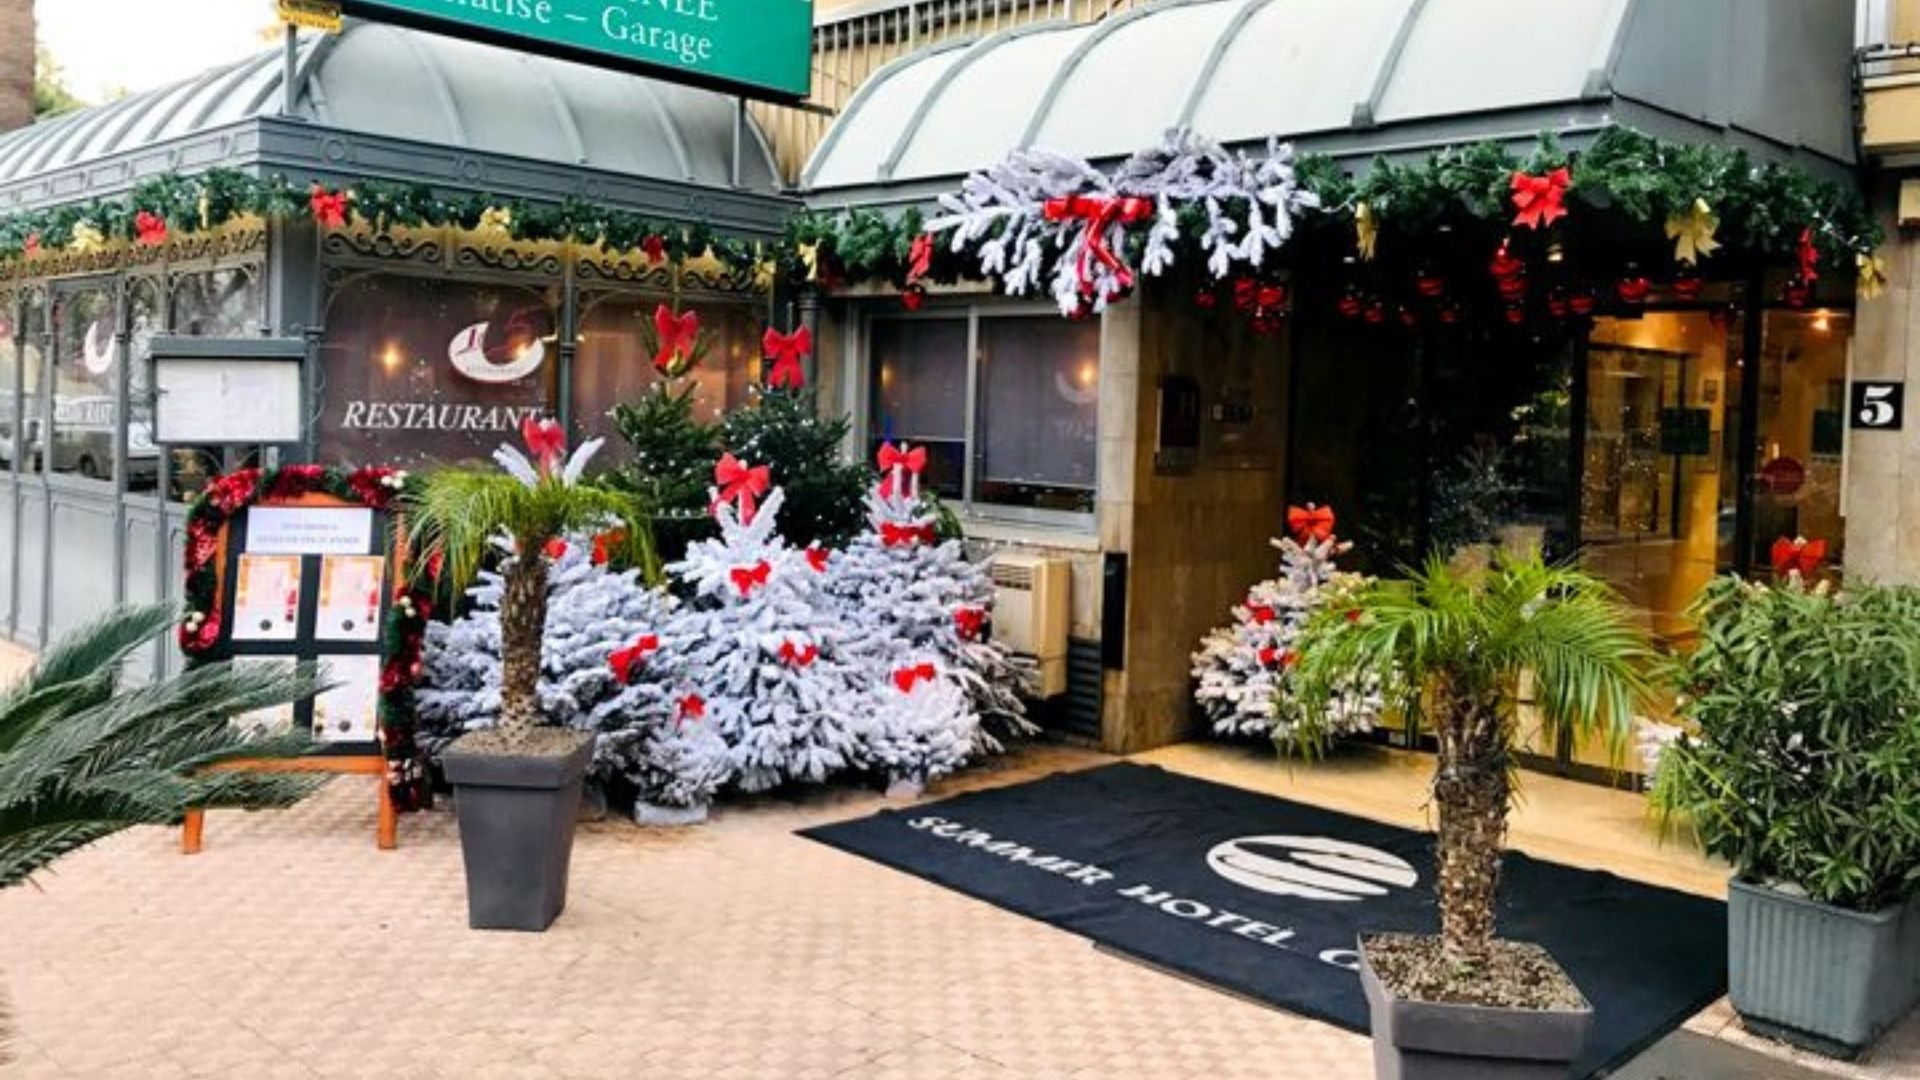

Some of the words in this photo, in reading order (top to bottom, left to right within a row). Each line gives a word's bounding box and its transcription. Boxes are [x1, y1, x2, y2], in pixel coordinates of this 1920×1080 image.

[602, 6, 711, 63] Garage
[341, 400, 545, 432] RESTAURANT
[1860, 385, 1894, 425] 5
[907, 817, 1114, 885] SUMMER
[1117, 884, 1296, 949] HOTEL
